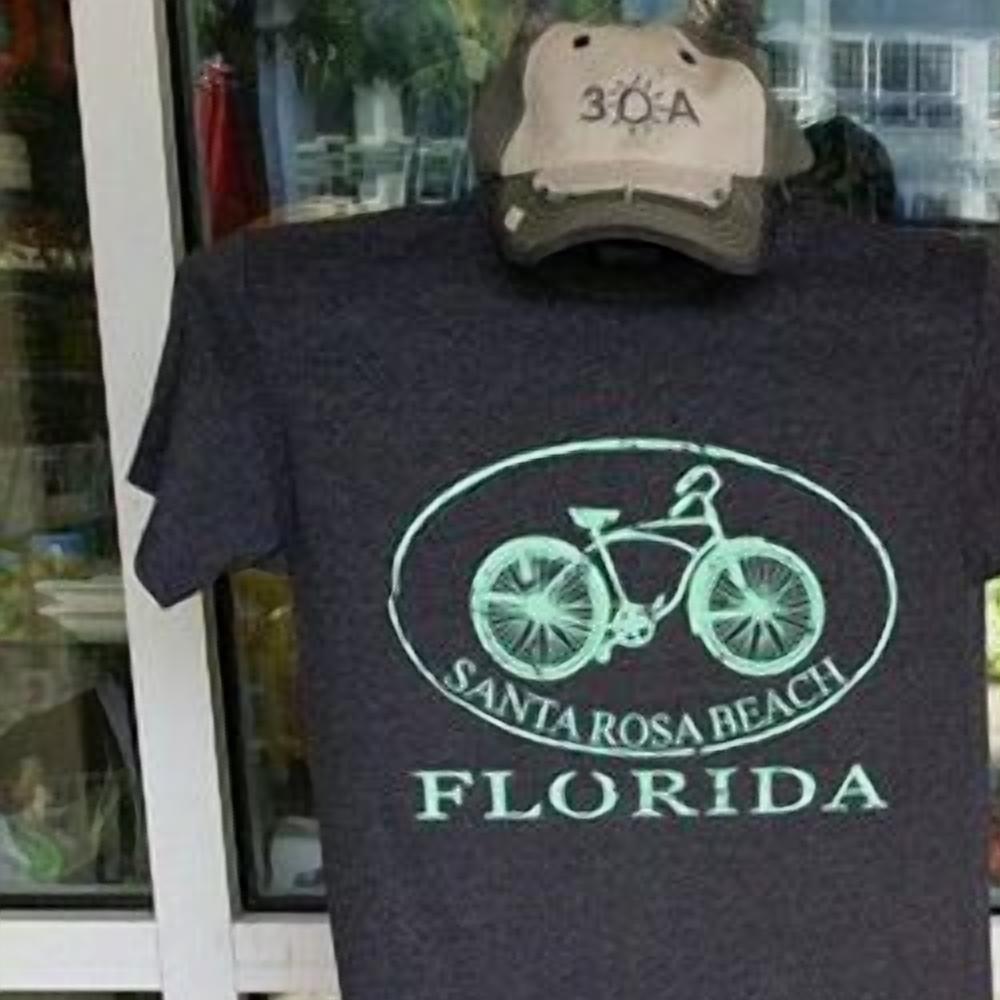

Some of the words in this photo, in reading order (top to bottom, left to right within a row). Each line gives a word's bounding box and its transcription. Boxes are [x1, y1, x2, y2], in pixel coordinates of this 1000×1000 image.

[444, 657, 580, 743] SANTA
[590, 711, 704, 748] ROSA
[709, 656, 848, 742] BEACH
[414, 763, 889, 821] FLORIDA
